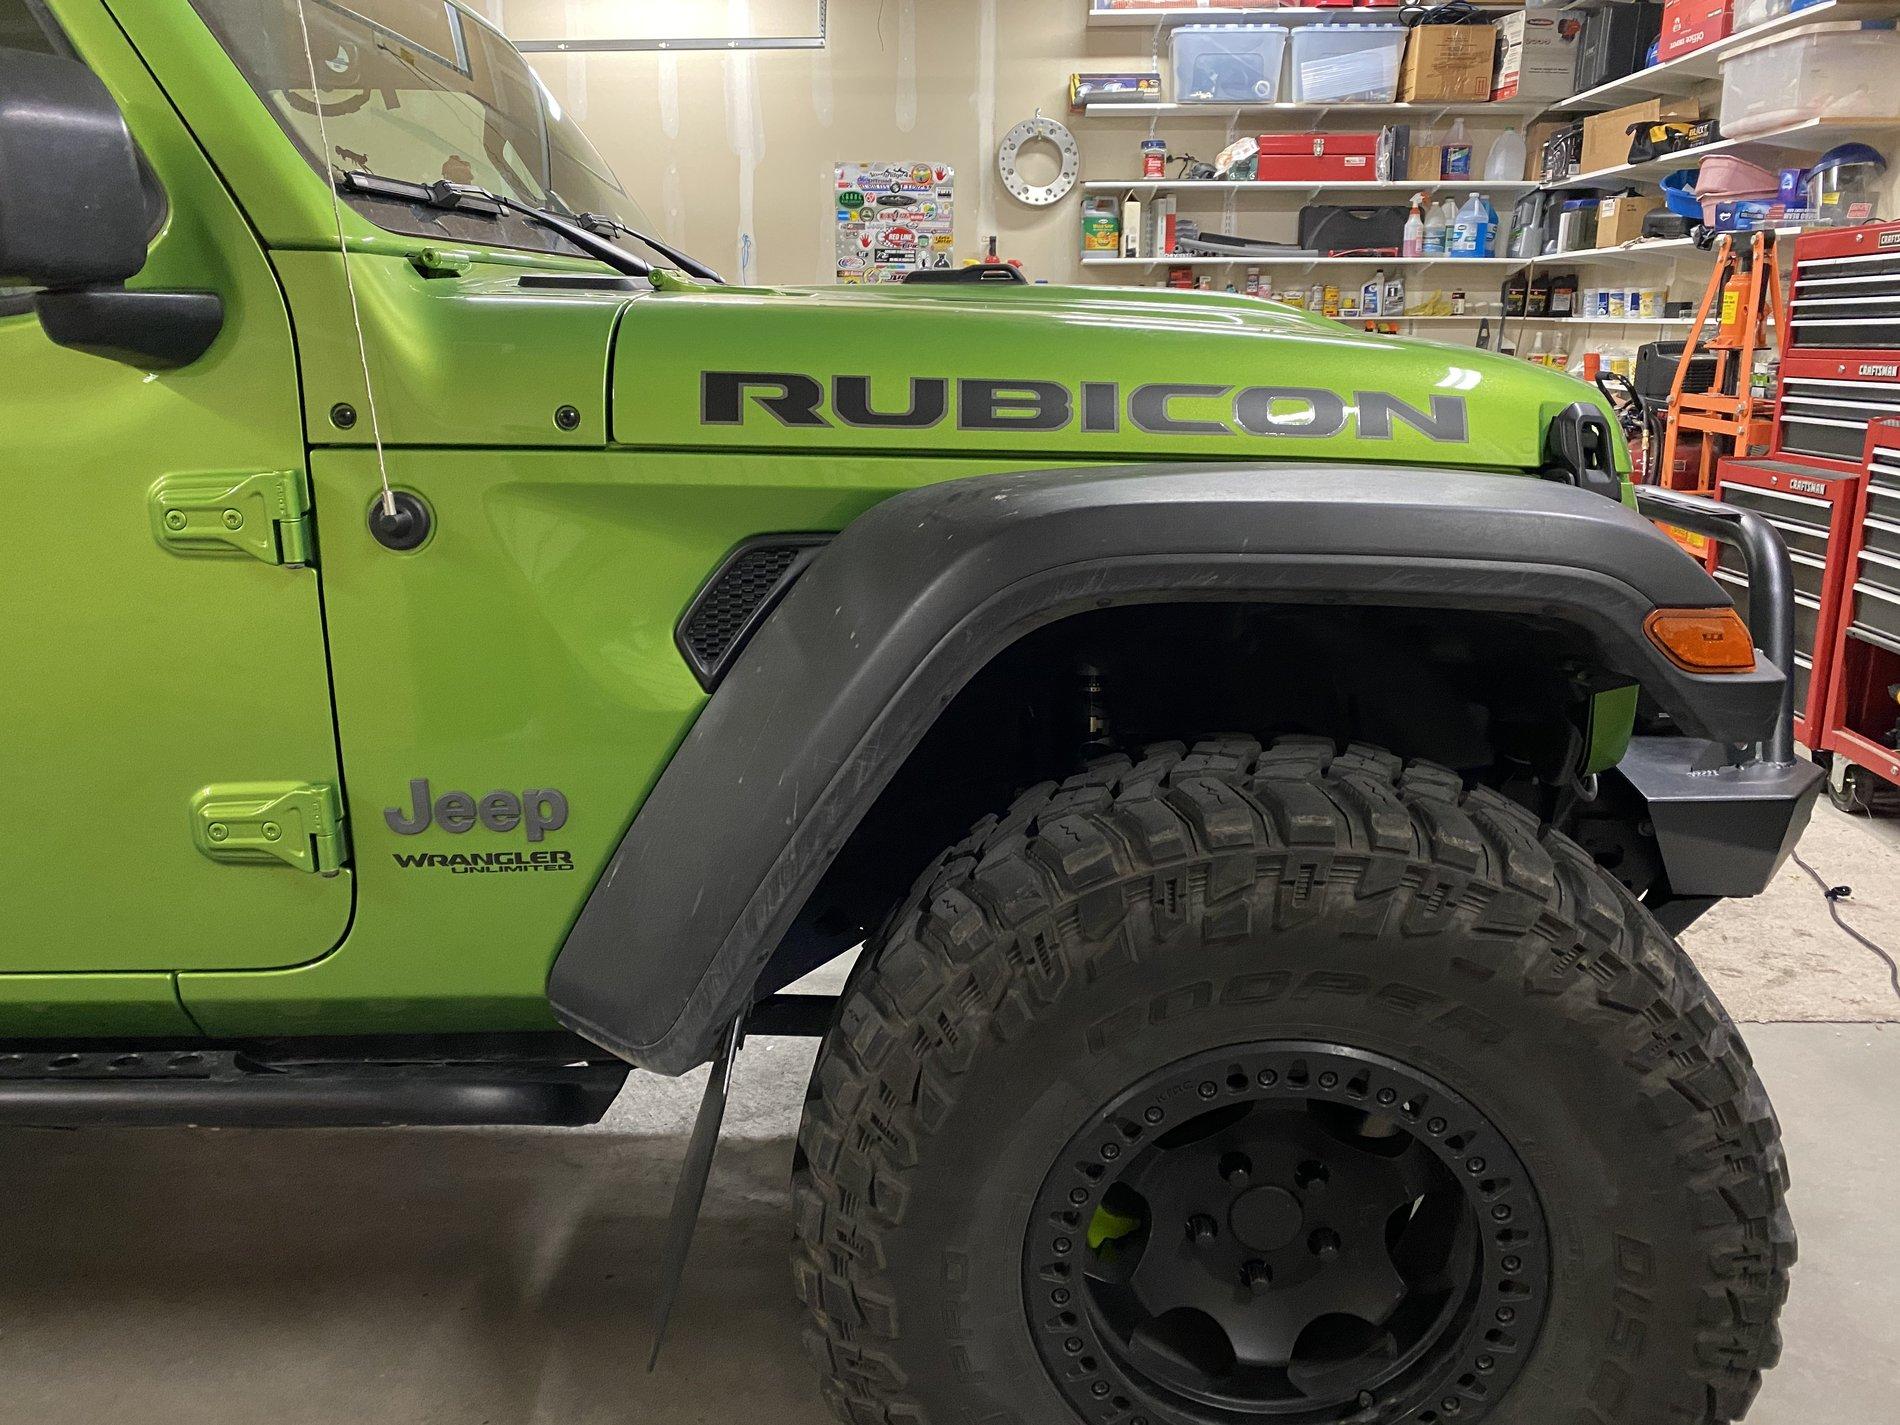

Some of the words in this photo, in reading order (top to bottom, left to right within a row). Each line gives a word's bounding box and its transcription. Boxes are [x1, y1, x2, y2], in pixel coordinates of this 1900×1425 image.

[888, 233, 900, 241] RED
[900, 233, 912, 241] LINE
[1881, 234, 1900, 244] CRAFTS
[1859, 364, 1897, 377] CRAFTSMAN
[699, 370, 1468, 443] RUBICON
[1790, 479, 1826, 495] CRAFTSMAN
[383, 778, 569, 842] Jeep
[392, 850, 574, 868] WRANGLER
[451, 864, 575, 874] UNLIMITED
